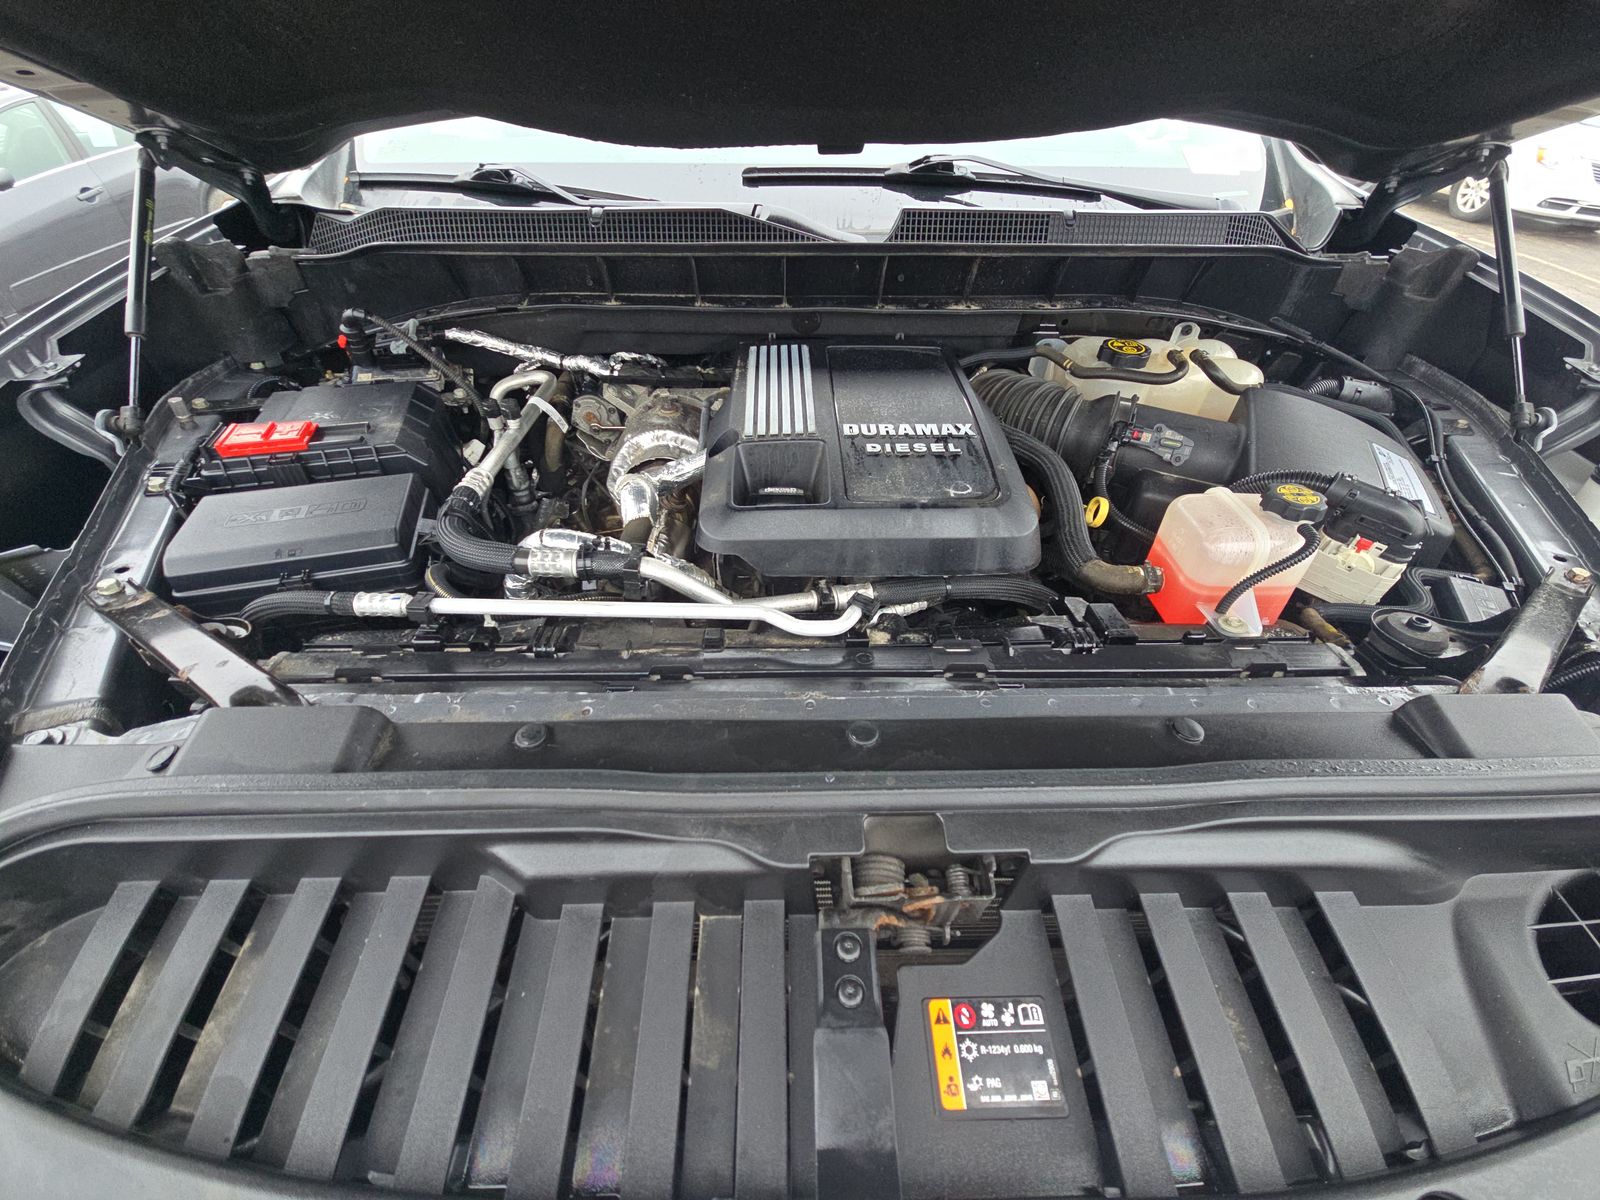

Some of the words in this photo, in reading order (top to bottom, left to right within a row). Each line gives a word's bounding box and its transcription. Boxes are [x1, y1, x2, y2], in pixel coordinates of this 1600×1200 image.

[842, 422, 978, 437] DURAMAX
[865, 442, 962, 455] DIESEL
[982, 1019, 998, 1027] AUTO
[1033, 1044, 1043, 1054] kg
[986, 1078, 1001, 1088] PAG
